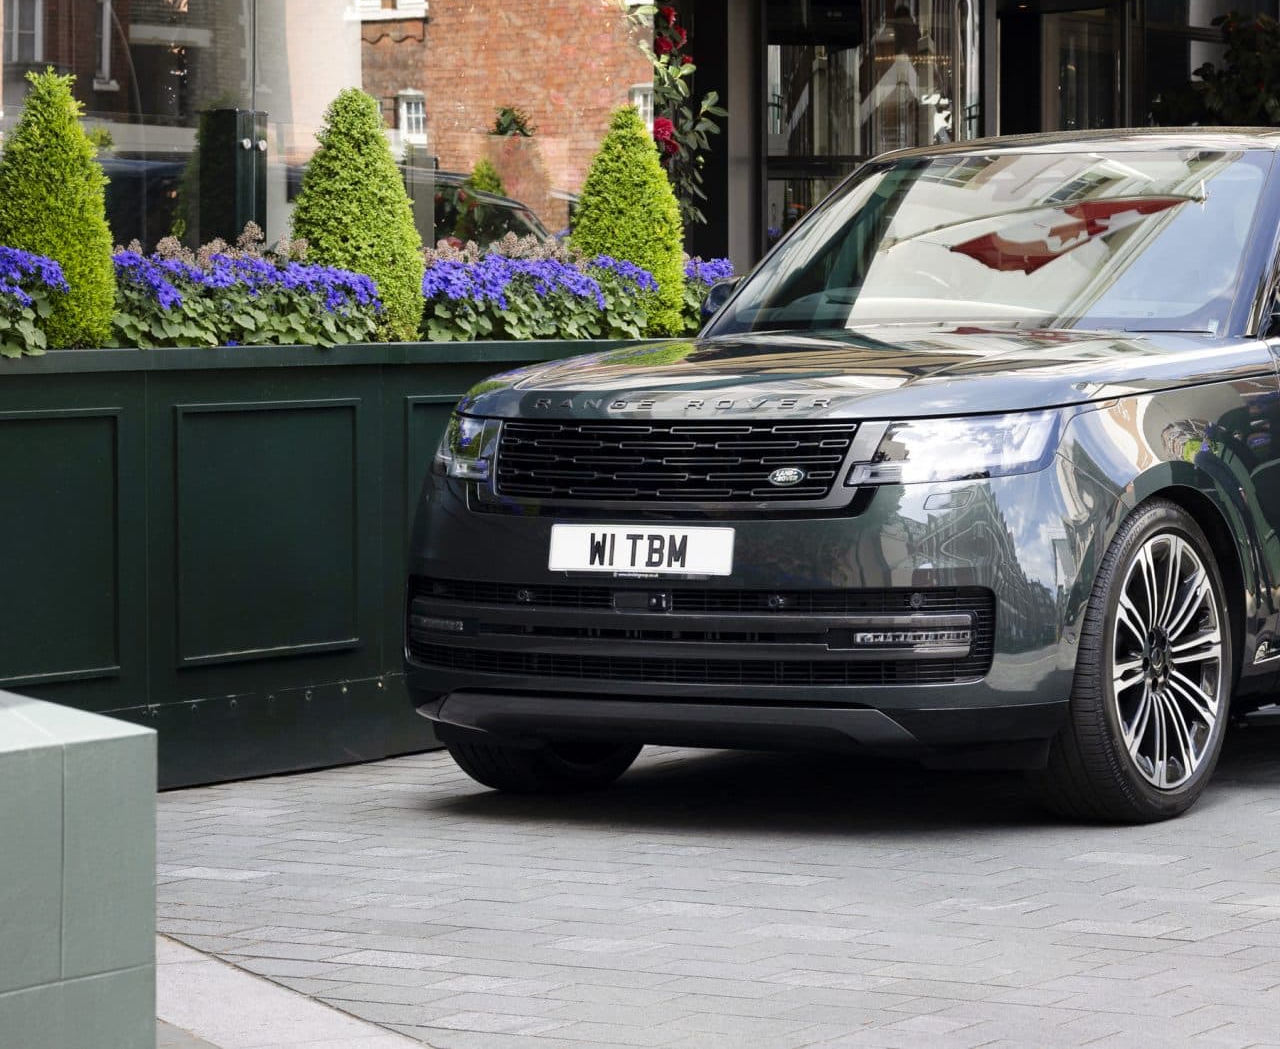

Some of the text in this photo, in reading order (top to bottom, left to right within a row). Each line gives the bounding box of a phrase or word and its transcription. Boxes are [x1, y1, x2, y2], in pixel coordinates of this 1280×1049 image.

[533, 398, 832, 410] RANGE ROVER
[626, 534, 689, 568] TBM
